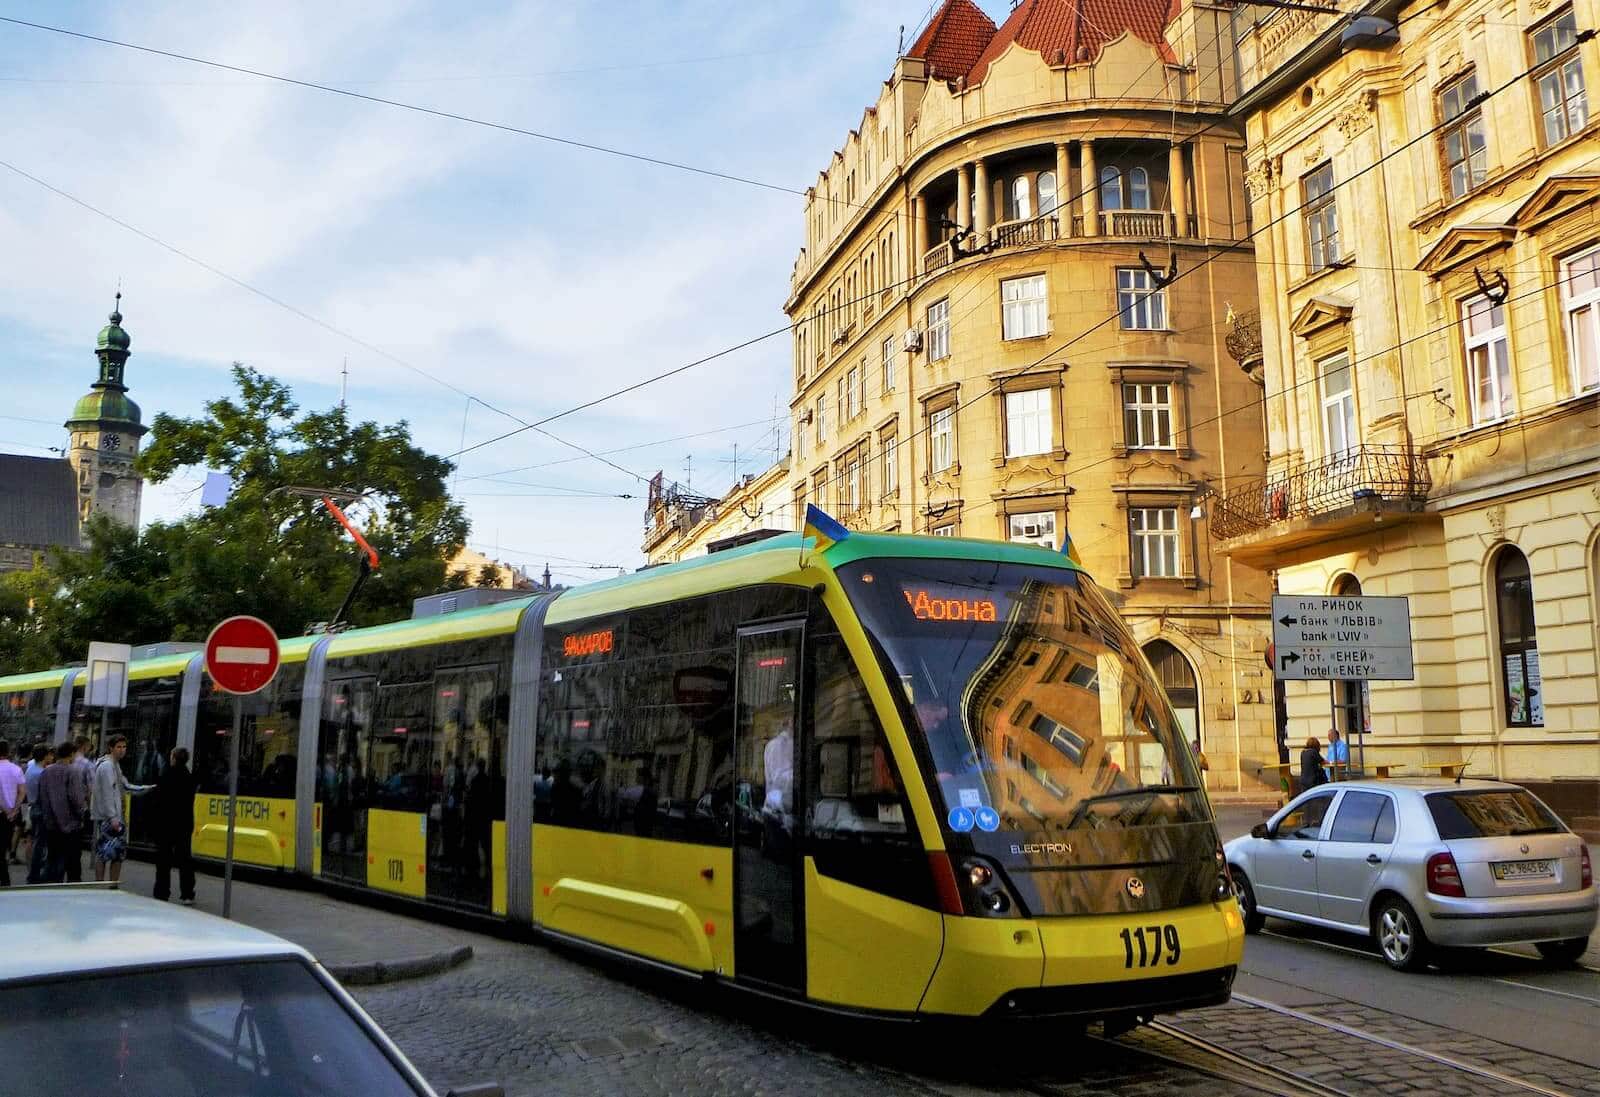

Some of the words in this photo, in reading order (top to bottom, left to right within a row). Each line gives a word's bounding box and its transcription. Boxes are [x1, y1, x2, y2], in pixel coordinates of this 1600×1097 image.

[1300, 602, 1317, 611] пл.
[1322, 600, 1363, 611] РИНОК
[1301, 616, 1328, 626] банк
[1335, 616, 1382, 626] «ЛЬВІВ»
[1301, 631, 1327, 641] bank
[1331, 631, 1369, 641] «LVIV»
[1330, 649, 1375, 662] «ЕНЕЙ»
[1304, 665, 1330, 676] hotel
[1334, 665, 1376, 676] «ENEY»
[1010, 843, 1072, 854] ELECTRON
[1120, 924, 1181, 968] 1179
